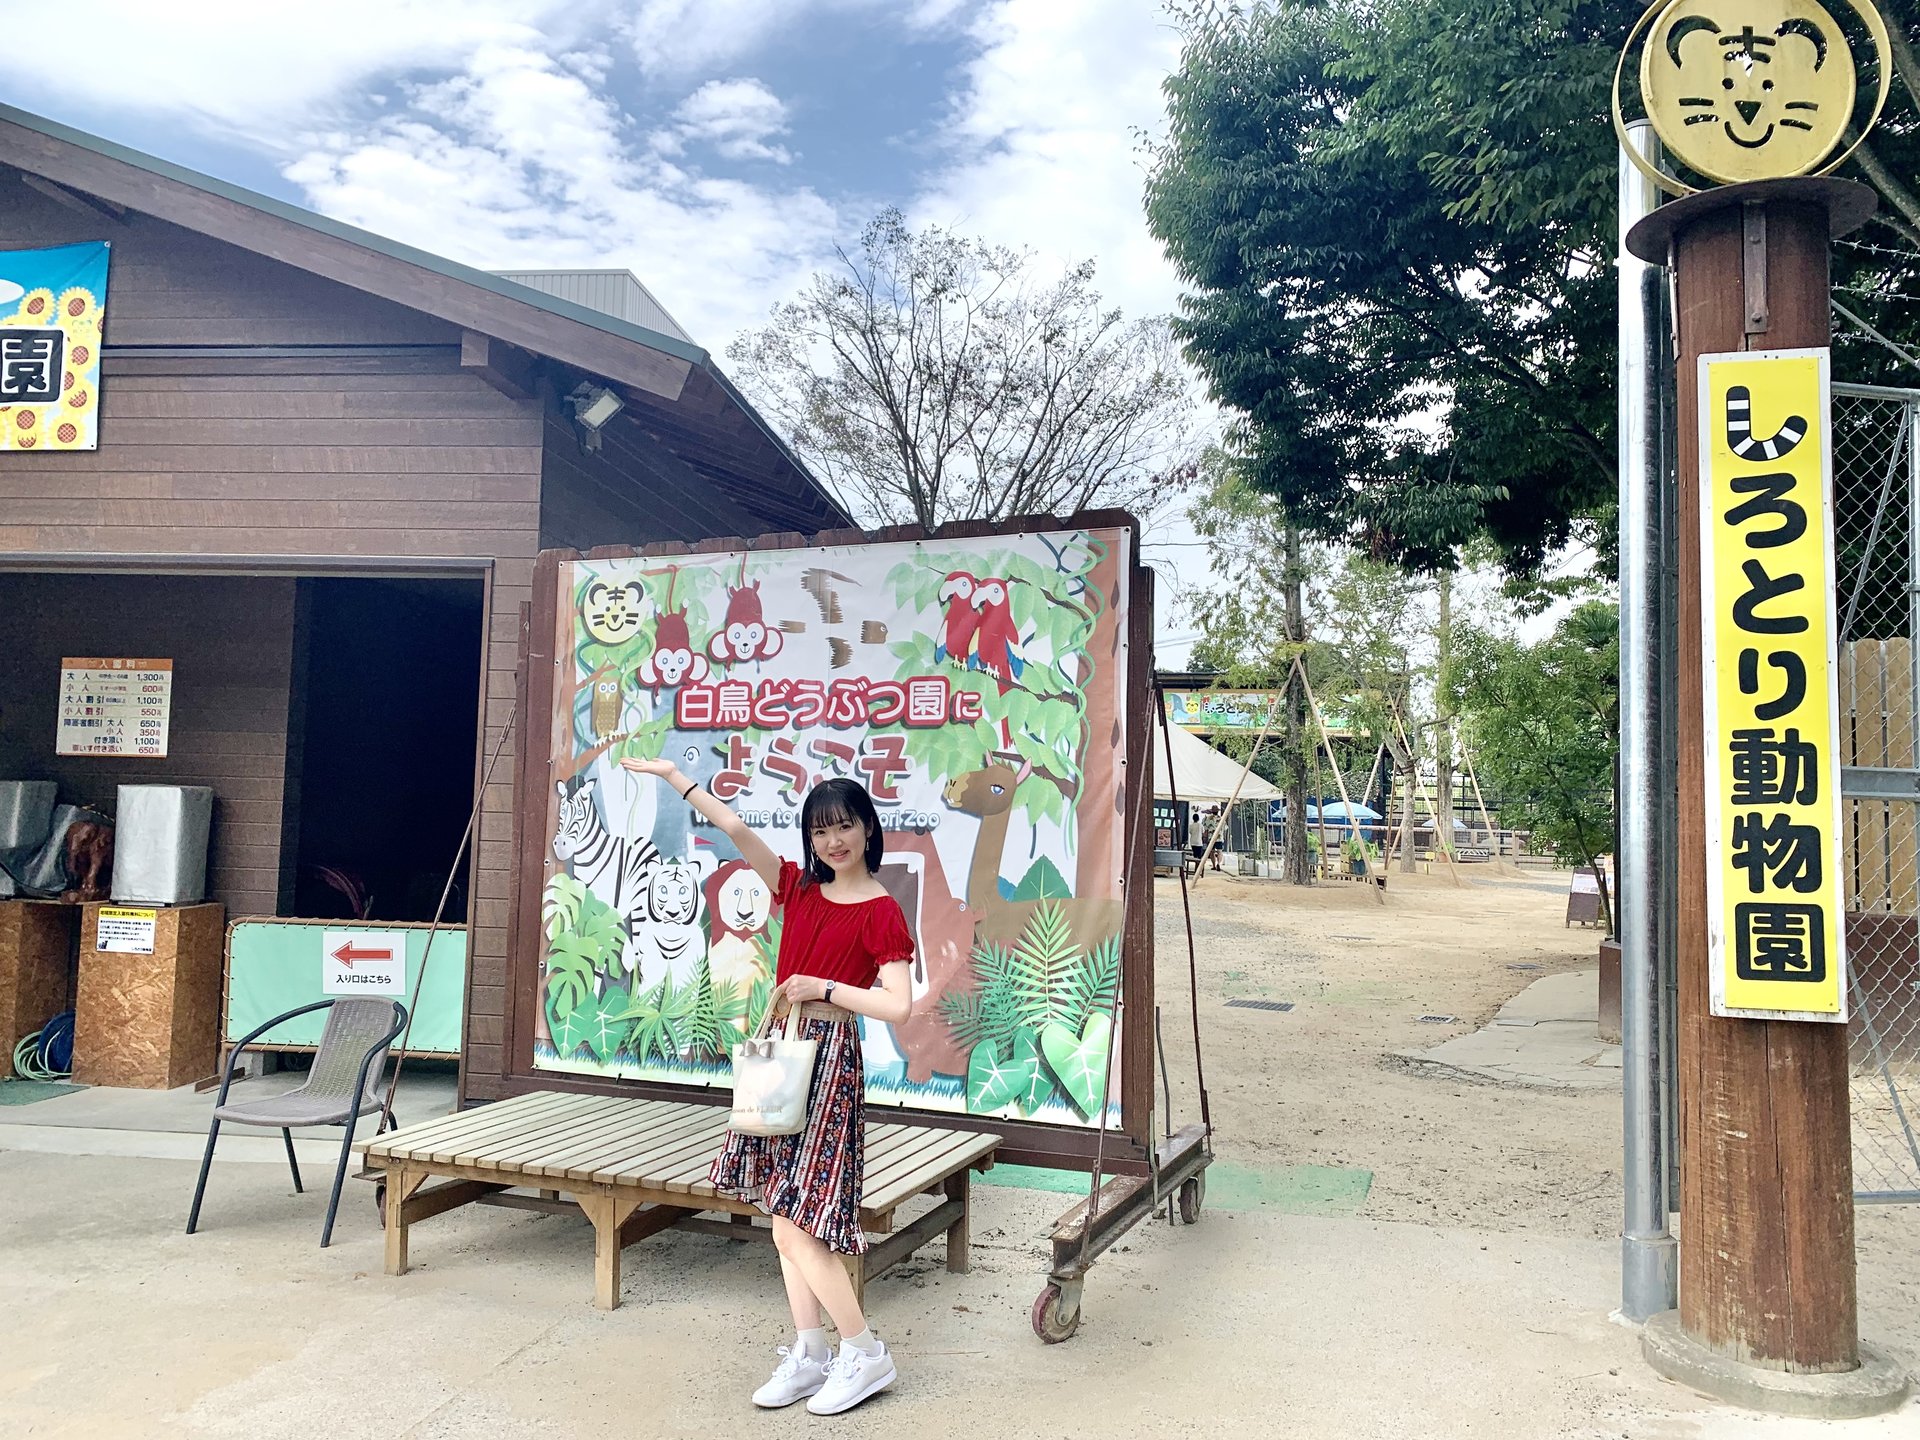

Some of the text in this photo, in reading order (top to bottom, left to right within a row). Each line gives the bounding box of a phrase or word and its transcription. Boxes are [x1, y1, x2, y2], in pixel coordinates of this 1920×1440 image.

[0, 329, 63, 402] 園
[1724, 385, 1826, 982] しろとり動物園
[711, 734, 912, 804] ようこそ
[774, 808, 794, 825] to
[903, 809, 940, 828] Zoo
[336, 974, 392, 984] 入り口はこちら
